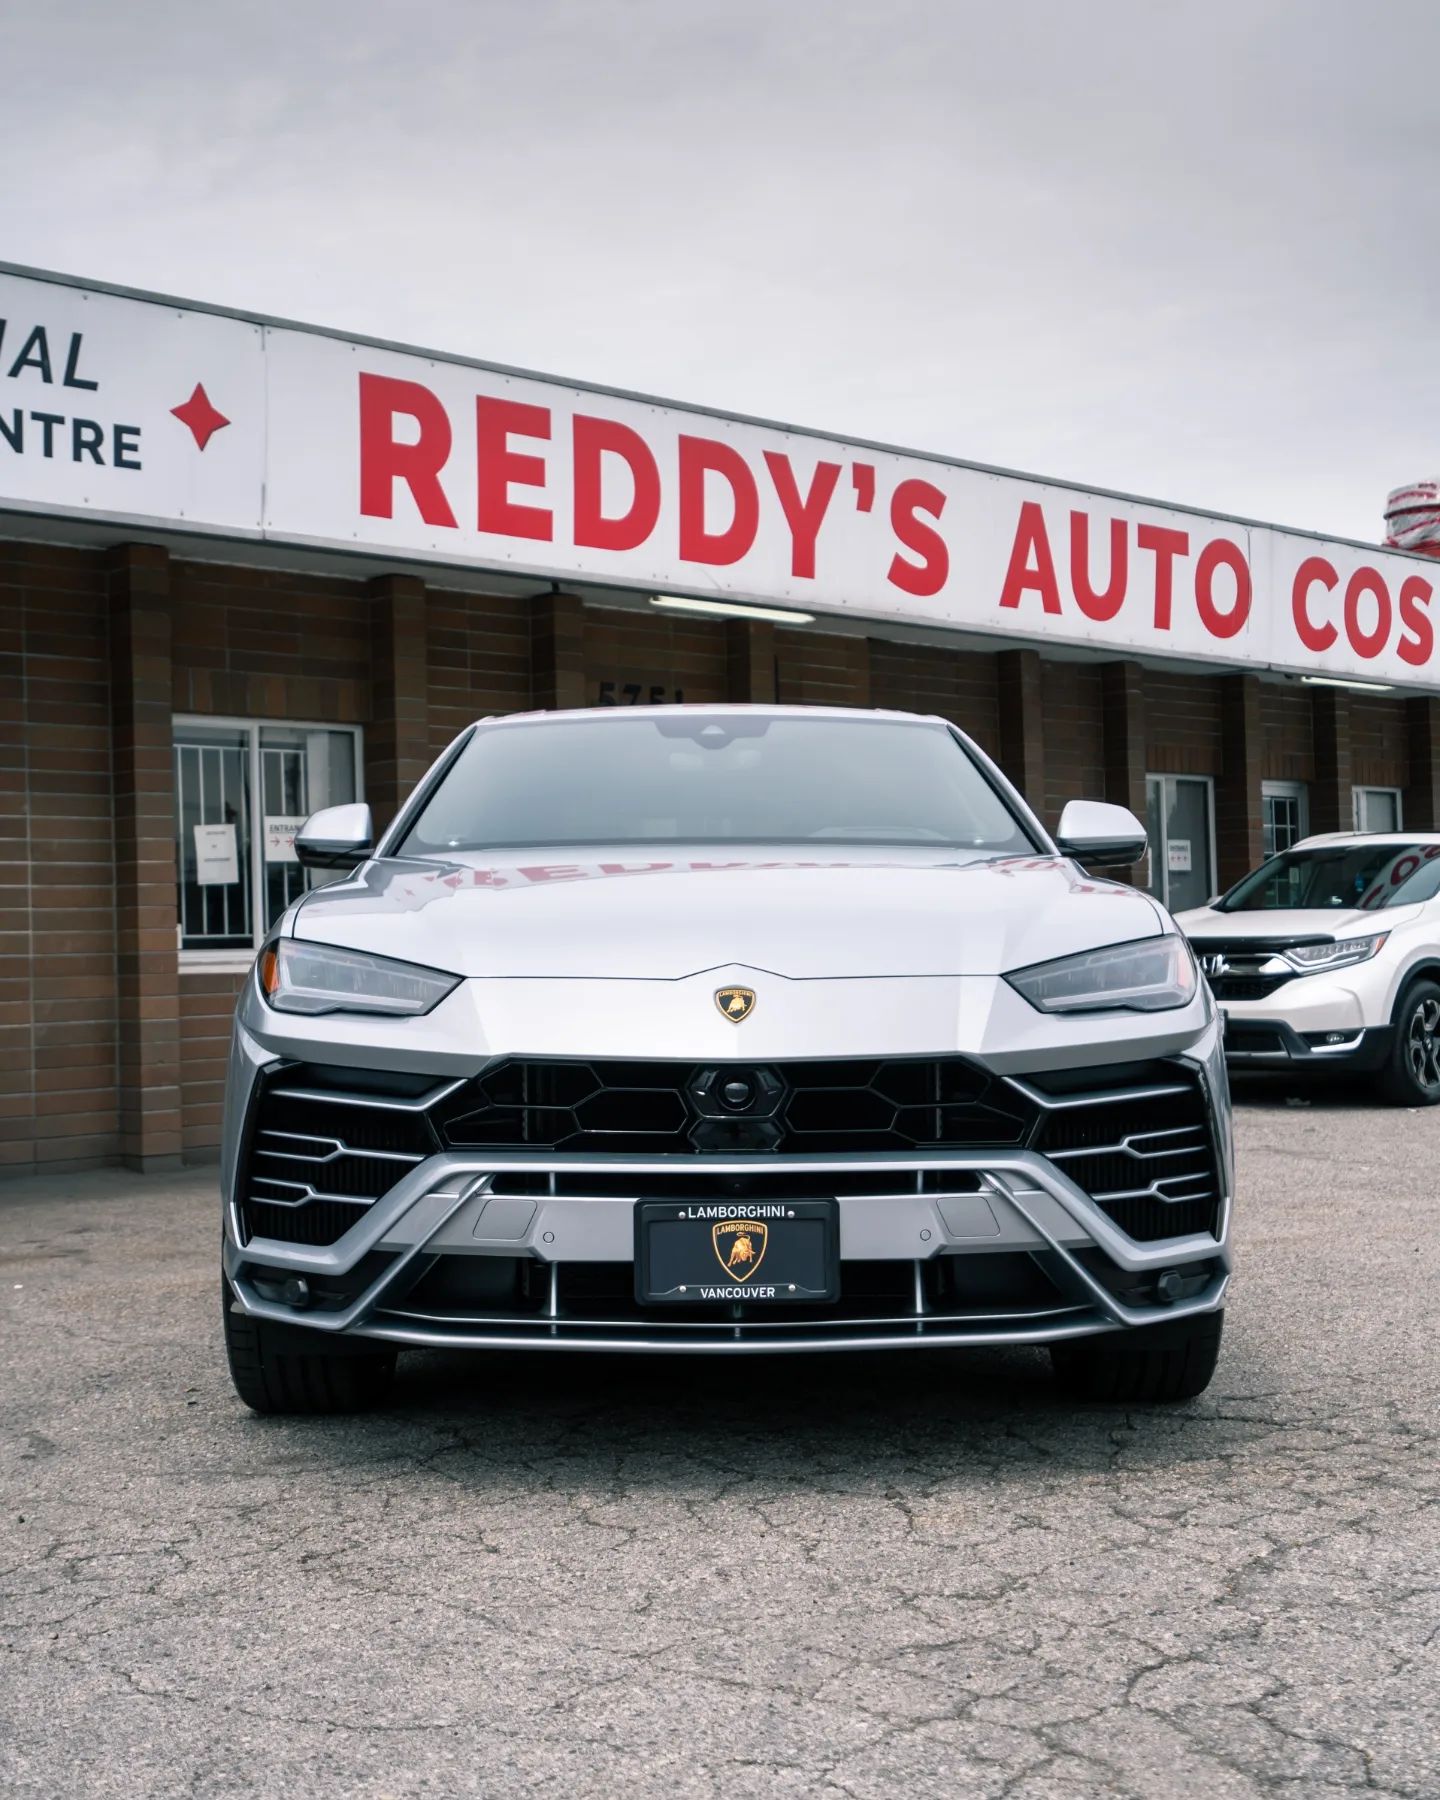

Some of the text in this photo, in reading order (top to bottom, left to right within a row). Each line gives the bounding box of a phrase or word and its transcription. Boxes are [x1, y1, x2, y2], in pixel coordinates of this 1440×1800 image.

[0, 318, 98, 391] AL
[0, 407, 142, 471] NTRE
[359, 372, 1434, 666] REDDY'S AUTO COS
[269, 824, 302, 833] ENTRAN
[687, 1205, 785, 1219] LAMBORGHINI
[716, 1223, 764, 1236] LAMBORGHINI
[700, 1286, 776, 1299] VANCOUVER
